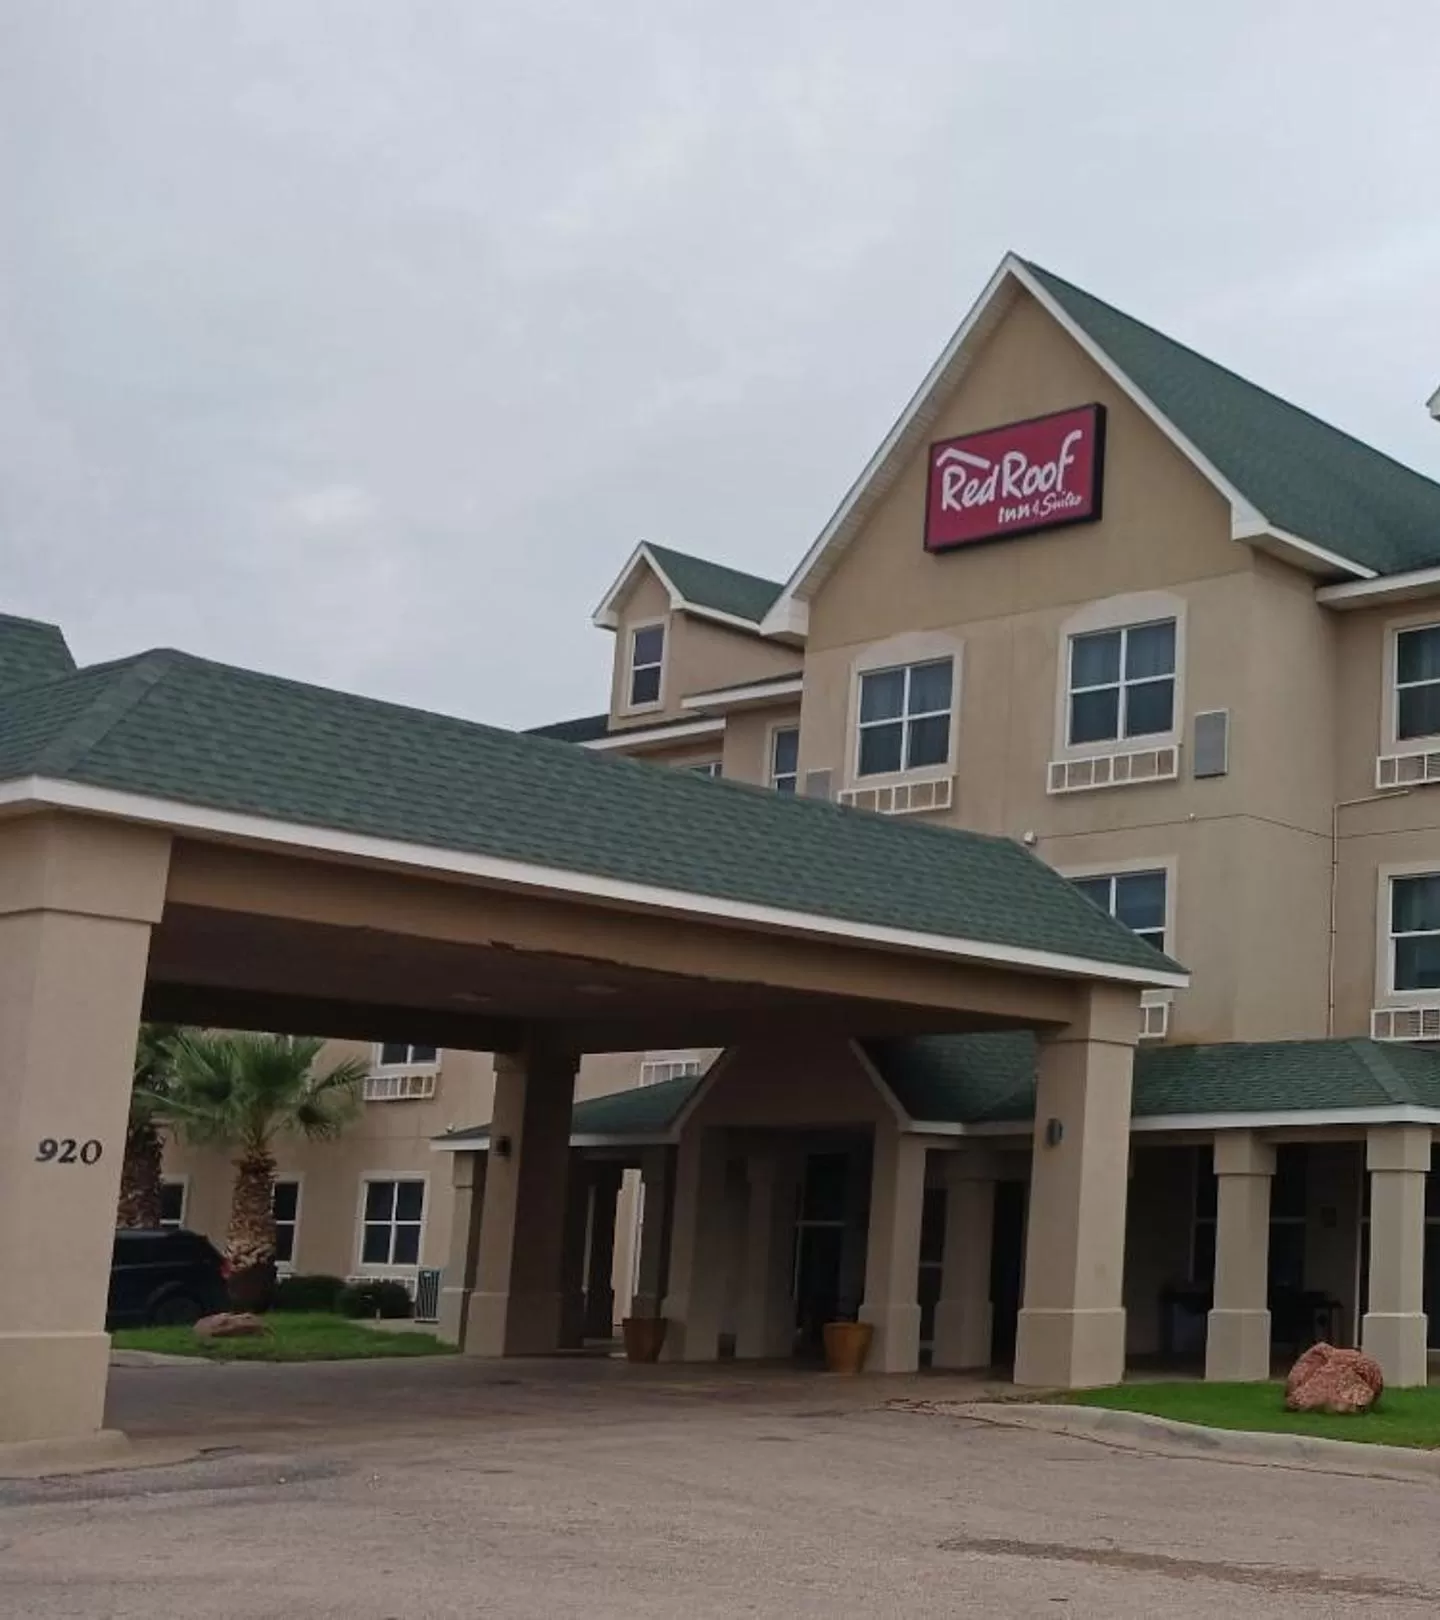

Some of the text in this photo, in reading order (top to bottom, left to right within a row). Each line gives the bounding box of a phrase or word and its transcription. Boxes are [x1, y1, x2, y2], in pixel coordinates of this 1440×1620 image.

[941, 429, 1083, 512] Red Roof
[34, 1138, 103, 1165] 920
